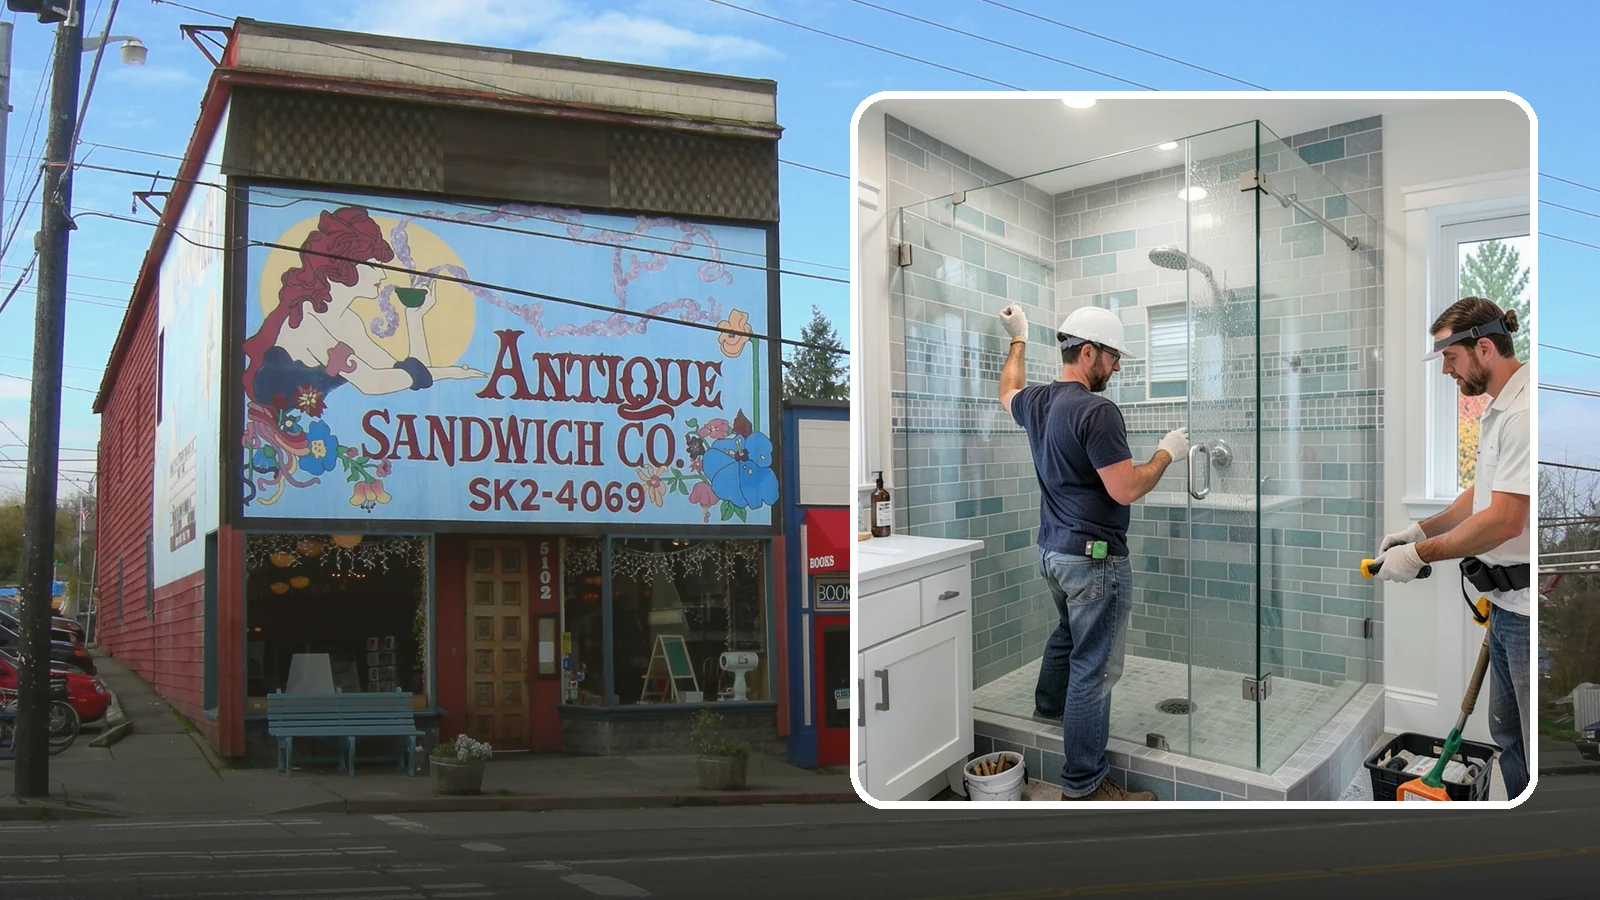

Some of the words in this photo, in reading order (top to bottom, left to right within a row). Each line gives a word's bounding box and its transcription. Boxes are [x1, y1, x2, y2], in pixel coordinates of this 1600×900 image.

[476, 329, 723, 420] ANTIQUE
[361, 409, 605, 467] SANDWICH
[617, 422, 686, 469] CO.
[468, 476, 646, 513] SK2-4069
[539, 542, 552, 600] 5102
[809, 555, 835, 569] BOOKS
